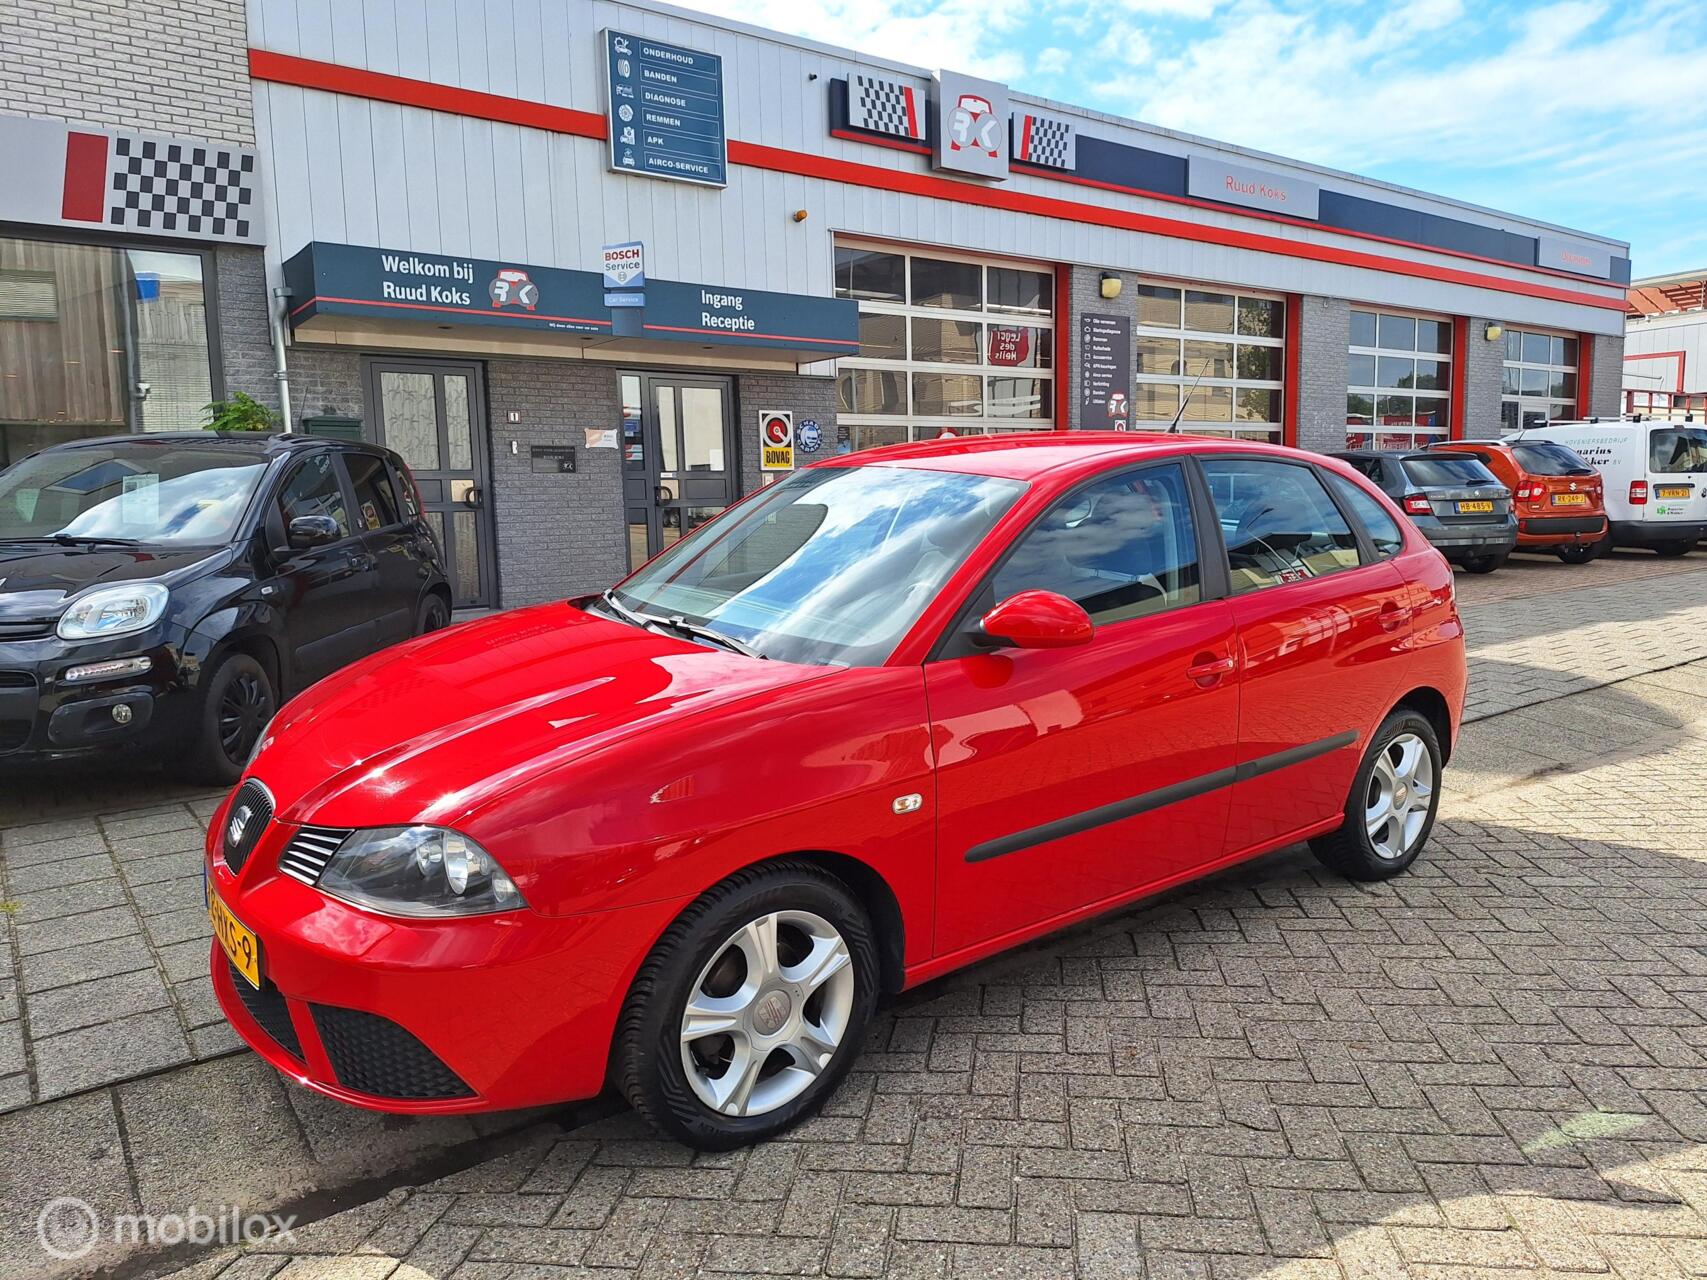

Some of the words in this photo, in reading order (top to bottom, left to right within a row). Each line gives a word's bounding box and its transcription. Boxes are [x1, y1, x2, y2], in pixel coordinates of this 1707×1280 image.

[643, 47, 694, 65] ONDERHOUD
[644, 70, 678, 83] BANDEN
[645, 92, 686, 107] DIAGNOSE
[646, 113, 681, 127] REMMEN
[647, 136, 664, 145] APK
[648, 157, 709, 174] AIRCO-SERVICE
[1226, 175, 1256, 194] Ruud
[1260, 184, 1286, 200] Koks
[605, 249, 640, 261] BOSCH
[381, 255, 450, 278] Welkom
[453, 262, 473, 284] bij
[605, 261, 640, 271] Service
[382, 282, 426, 301] Ruud
[431, 287, 471, 305] Koks
[701, 289, 743, 311] Ingang
[701, 312, 755, 332] Receptie
[766, 450, 790, 464] BOVAG
